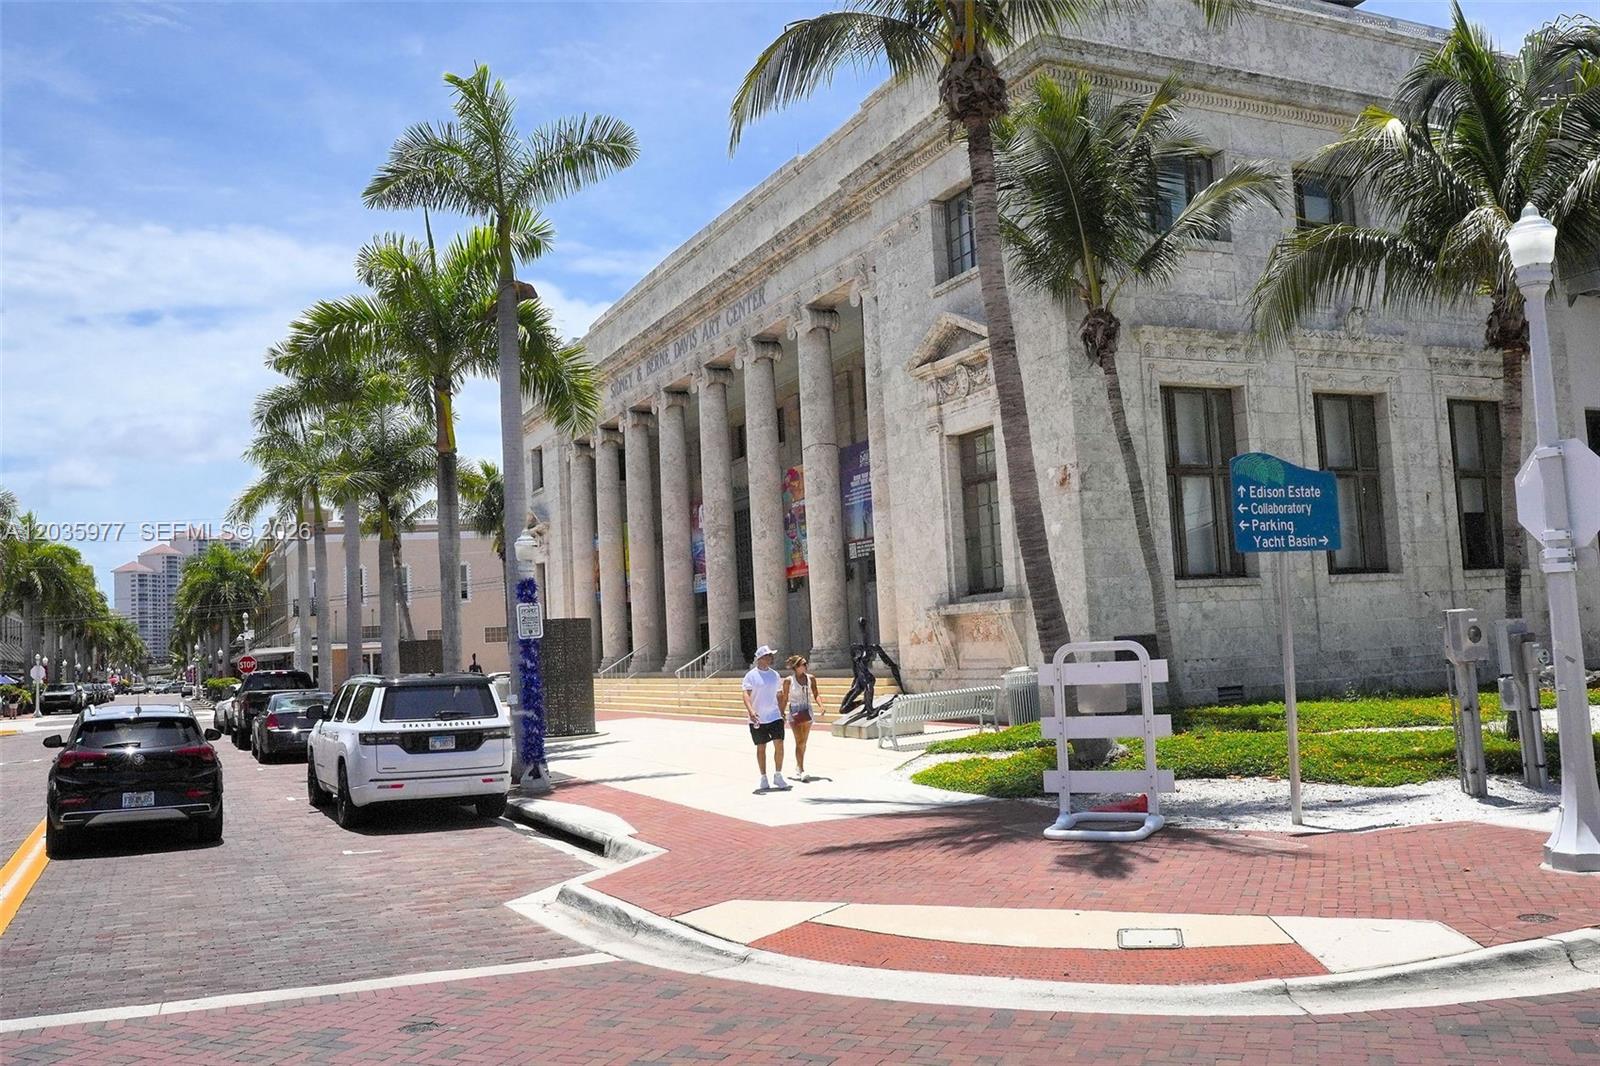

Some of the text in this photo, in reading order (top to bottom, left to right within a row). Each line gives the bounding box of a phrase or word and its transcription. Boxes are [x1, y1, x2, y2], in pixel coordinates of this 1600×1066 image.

[611, 286, 767, 398] SIDNEY & BERNE DAVIS ART CENTER
[1249, 485, 1321, 498] Edison Estate
[1251, 502, 1312, 516] Collaboratory
[1252, 519, 1294, 534] Parking
[1253, 534, 1317, 548] Yacht Basin
[239, 661, 256, 669] STOP
